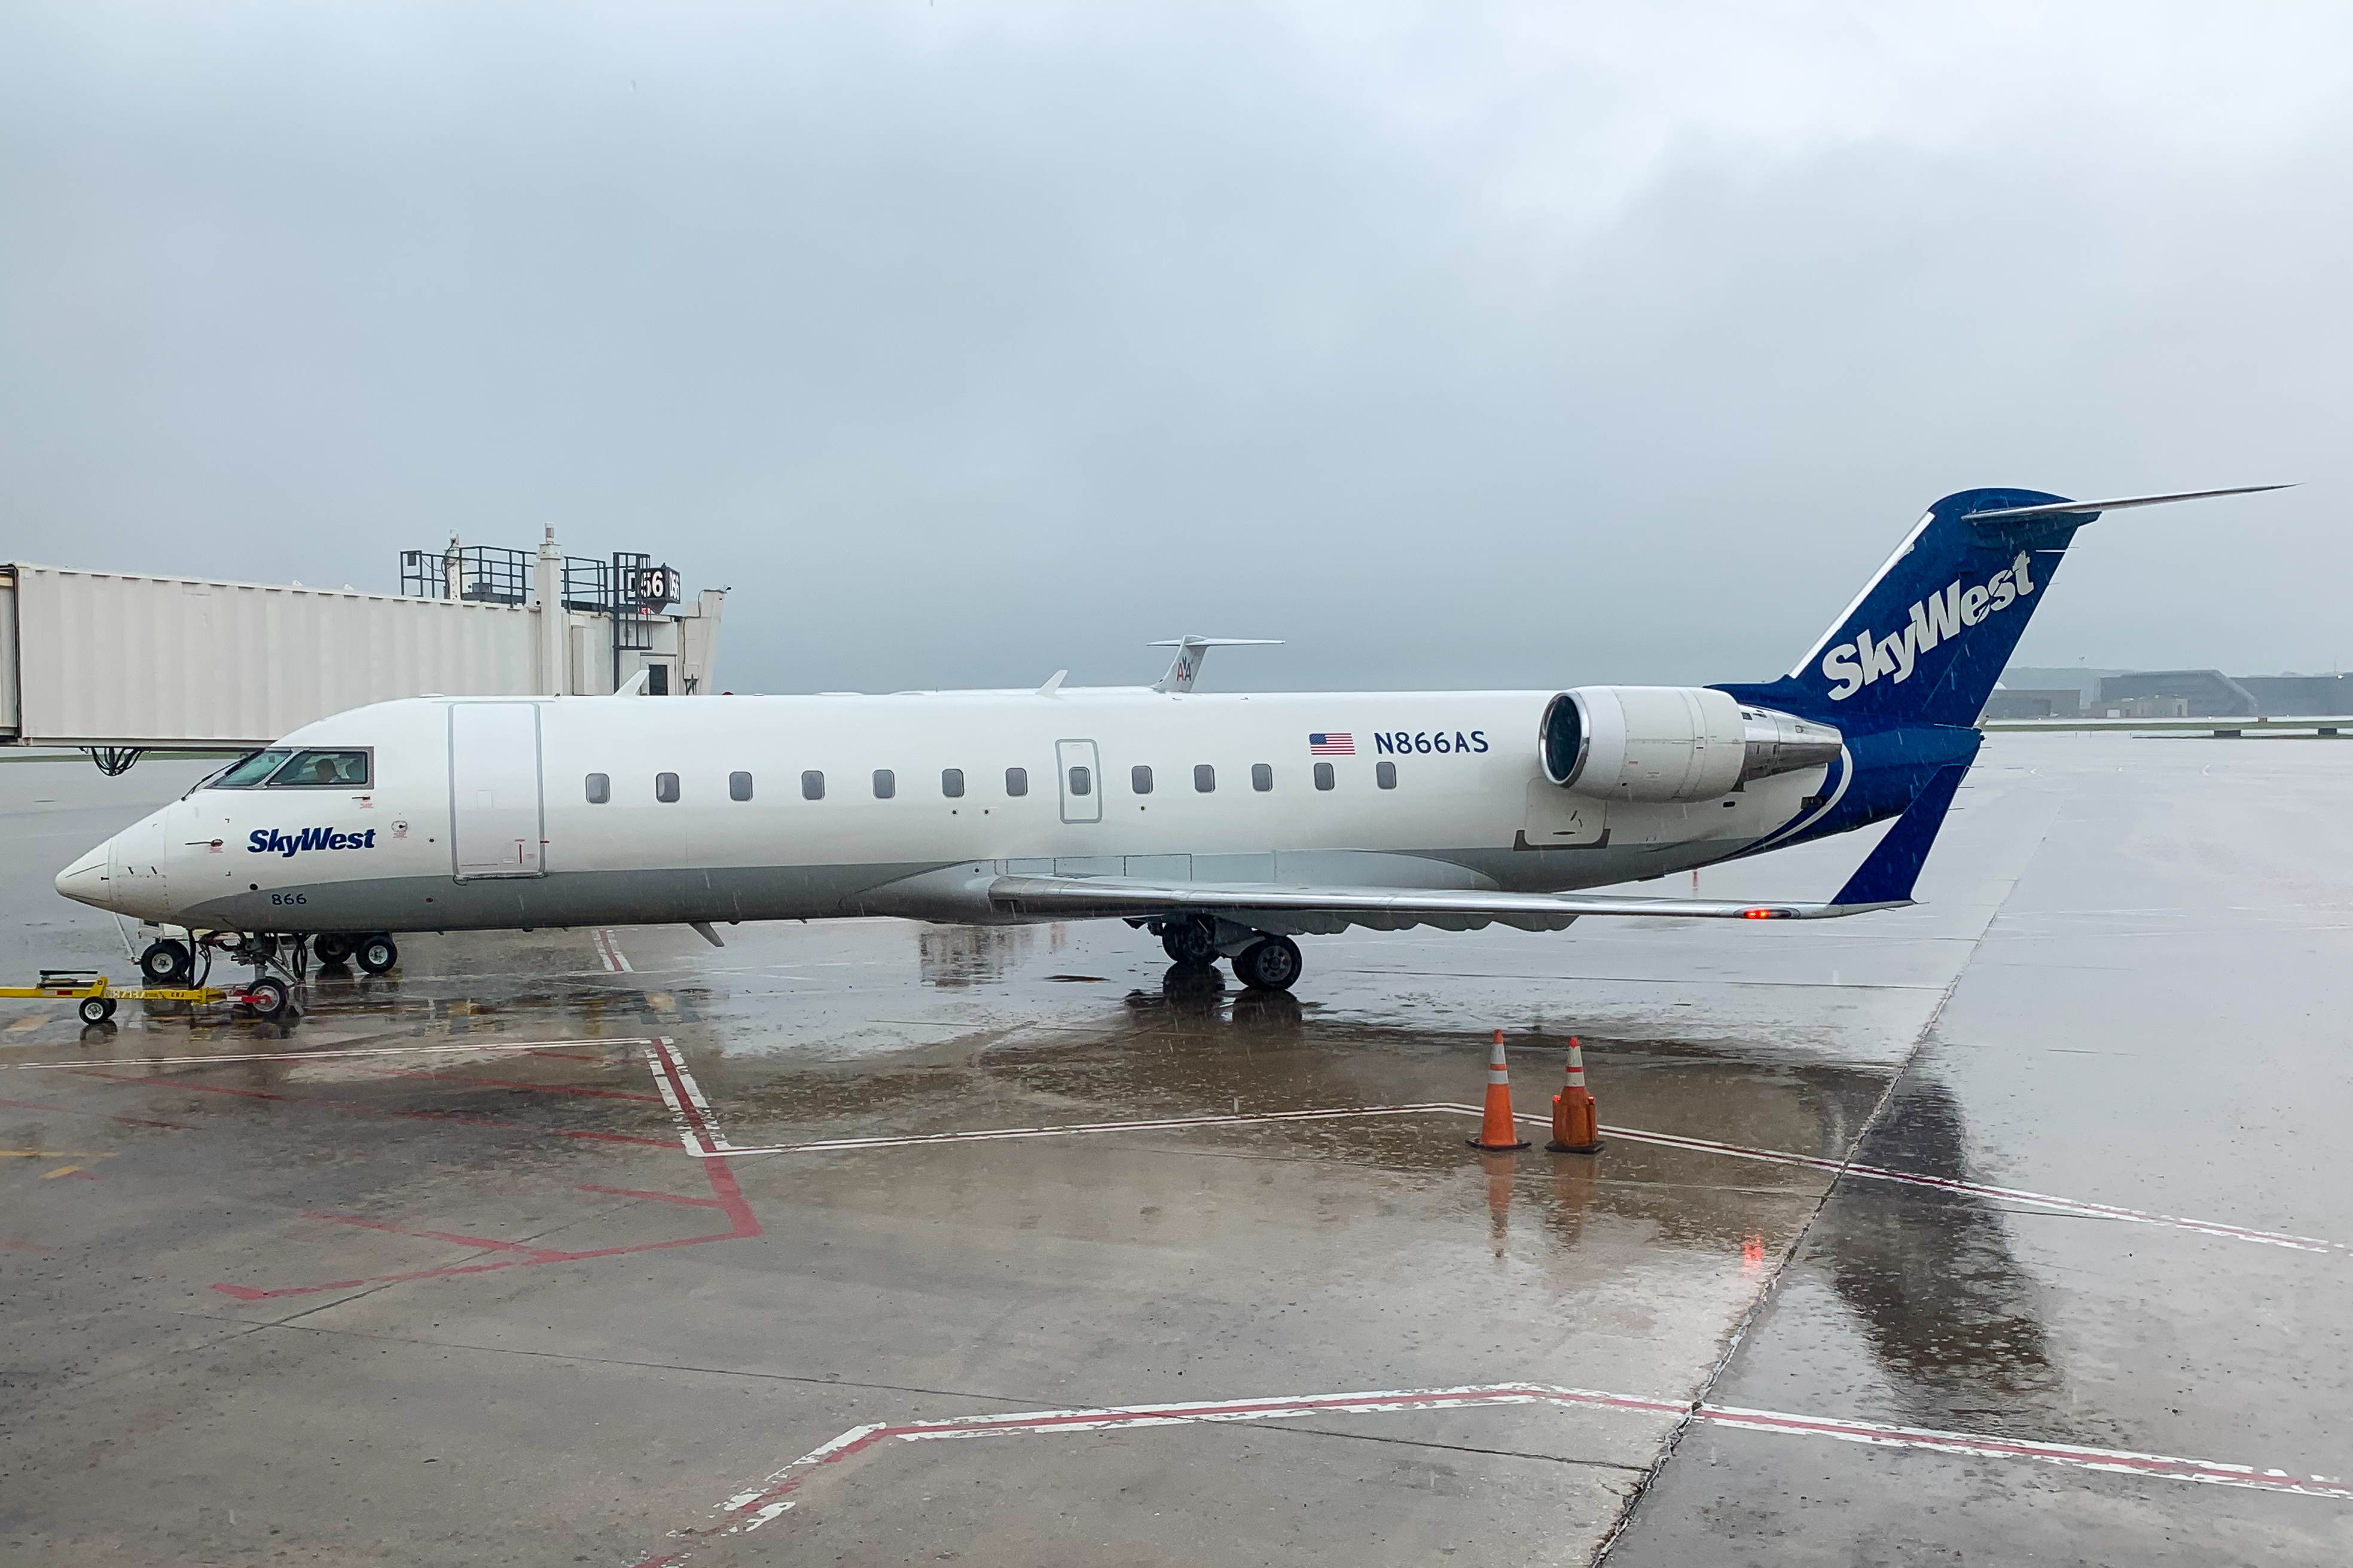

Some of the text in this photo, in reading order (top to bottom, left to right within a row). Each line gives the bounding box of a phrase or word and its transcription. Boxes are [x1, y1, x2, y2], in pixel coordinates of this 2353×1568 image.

[1822, 549, 2034, 701] SkyWest
[1176, 662, 1192, 681] AA
[1374, 730, 1489, 754] N866AS
[246, 826, 376, 858] SkyWest
[271, 893, 307, 906] 866
